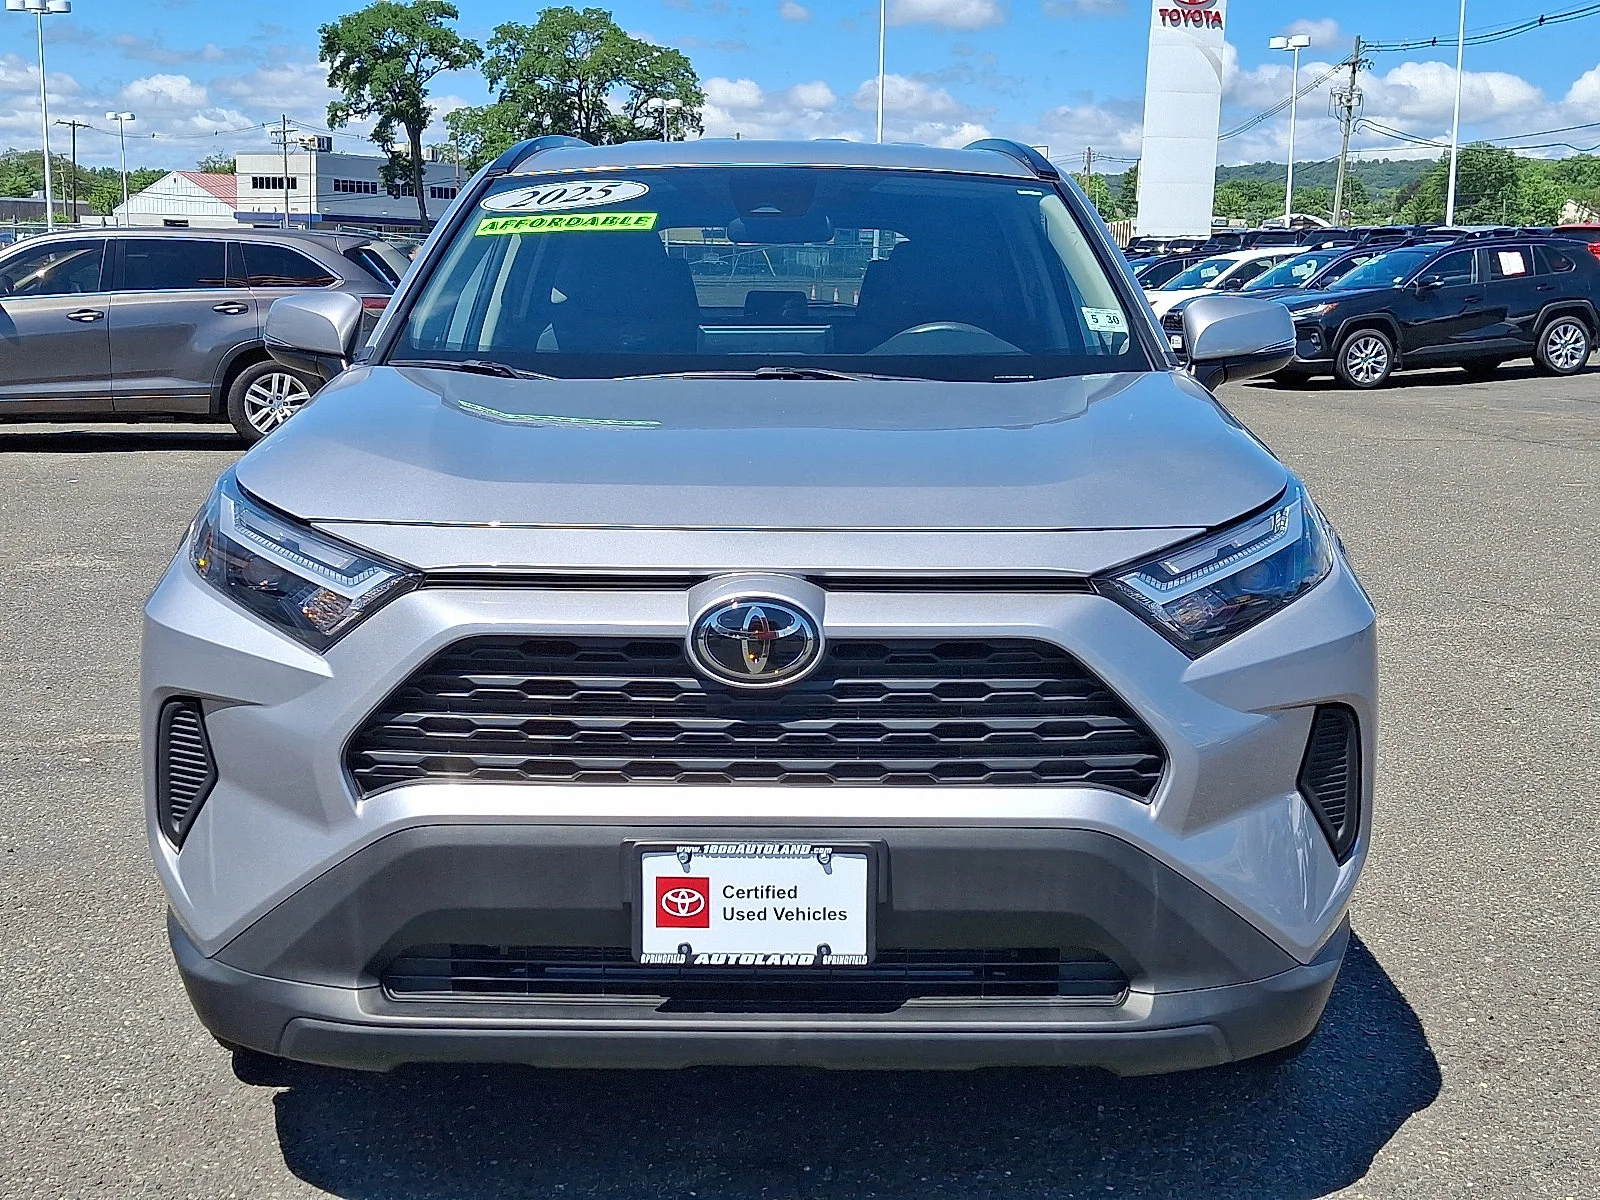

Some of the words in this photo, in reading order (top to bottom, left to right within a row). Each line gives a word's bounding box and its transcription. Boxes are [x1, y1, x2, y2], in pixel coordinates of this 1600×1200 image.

[1158, 8, 1223, 29] TOYOTA
[505, 183, 624, 209] 2025
[480, 215, 653, 232] AFFORDABLE
[1091, 314, 1099, 323] 5
[1105, 315, 1120, 324] 30
[676, 843, 833, 855] www.1800AUTOLAND.com
[722, 884, 798, 899] Certified
[722, 906, 767, 921] Used
[773, 906, 848, 921] Vehicles
[640, 953, 687, 965] SPRINGFIELD
[693, 953, 816, 966] AUTOLAND
[822, 954, 868, 966] SPRINGFIELD
